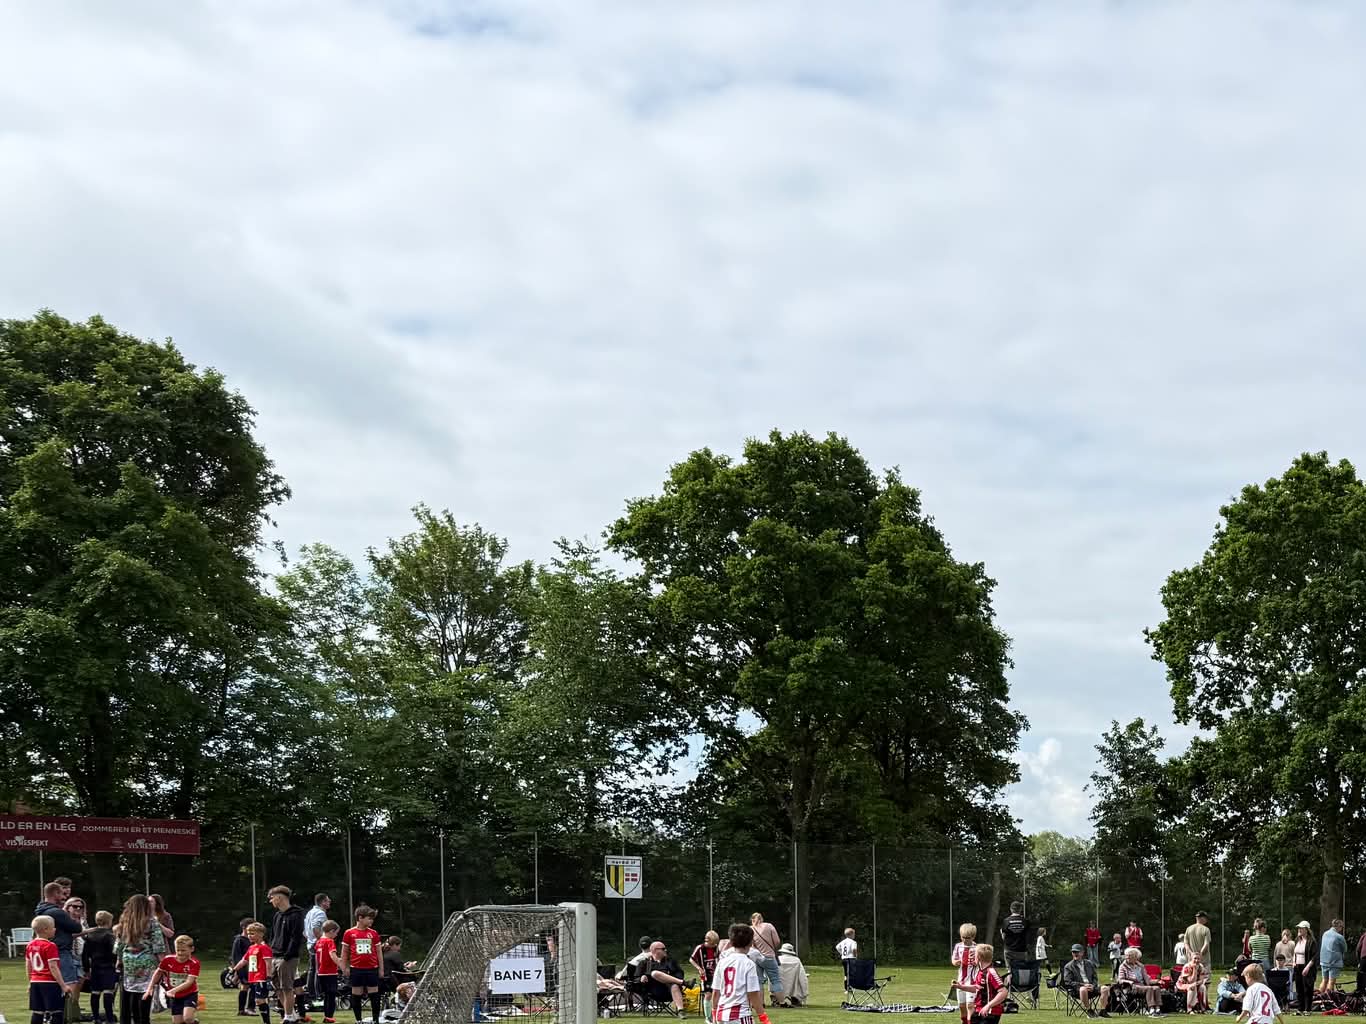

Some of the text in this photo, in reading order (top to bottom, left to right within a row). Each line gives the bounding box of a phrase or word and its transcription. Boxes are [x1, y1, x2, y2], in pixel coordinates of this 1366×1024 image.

[18, 822, 33, 831] ER
[35, 822, 51, 831] EN
[54, 823, 76, 832] LEG
[82, 825, 130, 834] DOMMEREN
[130, 826, 141, 834] ER
[153, 827, 197, 836] MENNESKE
[5, 838, 49, 847] VIS RESPEKT
[356, 943, 373, 955] BR
[29, 951, 45, 972] 10
[494, 969, 542, 981] BANE 7
[723, 966, 737, 998] 8
[1260, 990, 1271, 1016] 2
